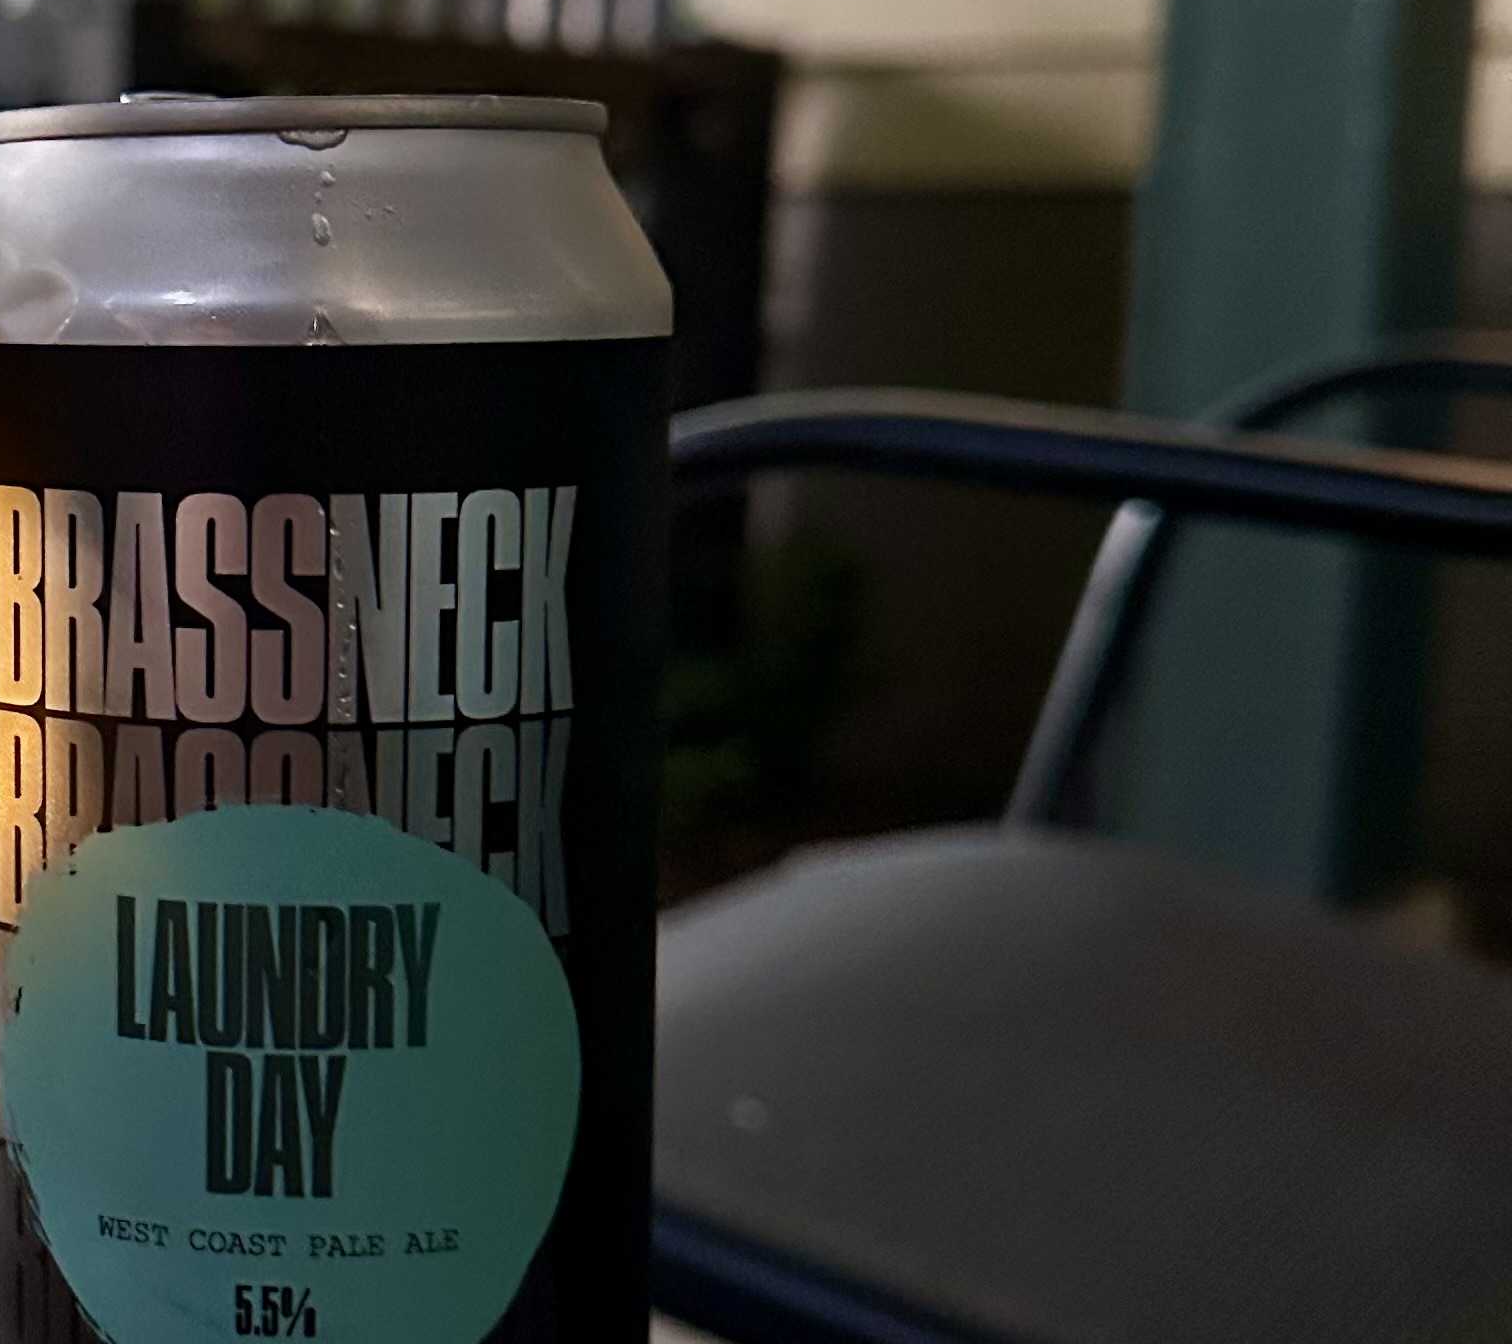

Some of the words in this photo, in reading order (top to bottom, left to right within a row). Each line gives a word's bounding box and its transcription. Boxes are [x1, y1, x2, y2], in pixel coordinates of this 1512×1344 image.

[117, 896, 440, 1050] LAUNDRY
[206, 1052, 347, 1198] DAY
[98, 1214, 170, 1248] WEST
[189, 1228, 287, 1257] COAST
[309, 1233, 385, 1257] PALE
[404, 1228, 461, 1255] ALE
[234, 1284, 317, 1339] 5.5%
